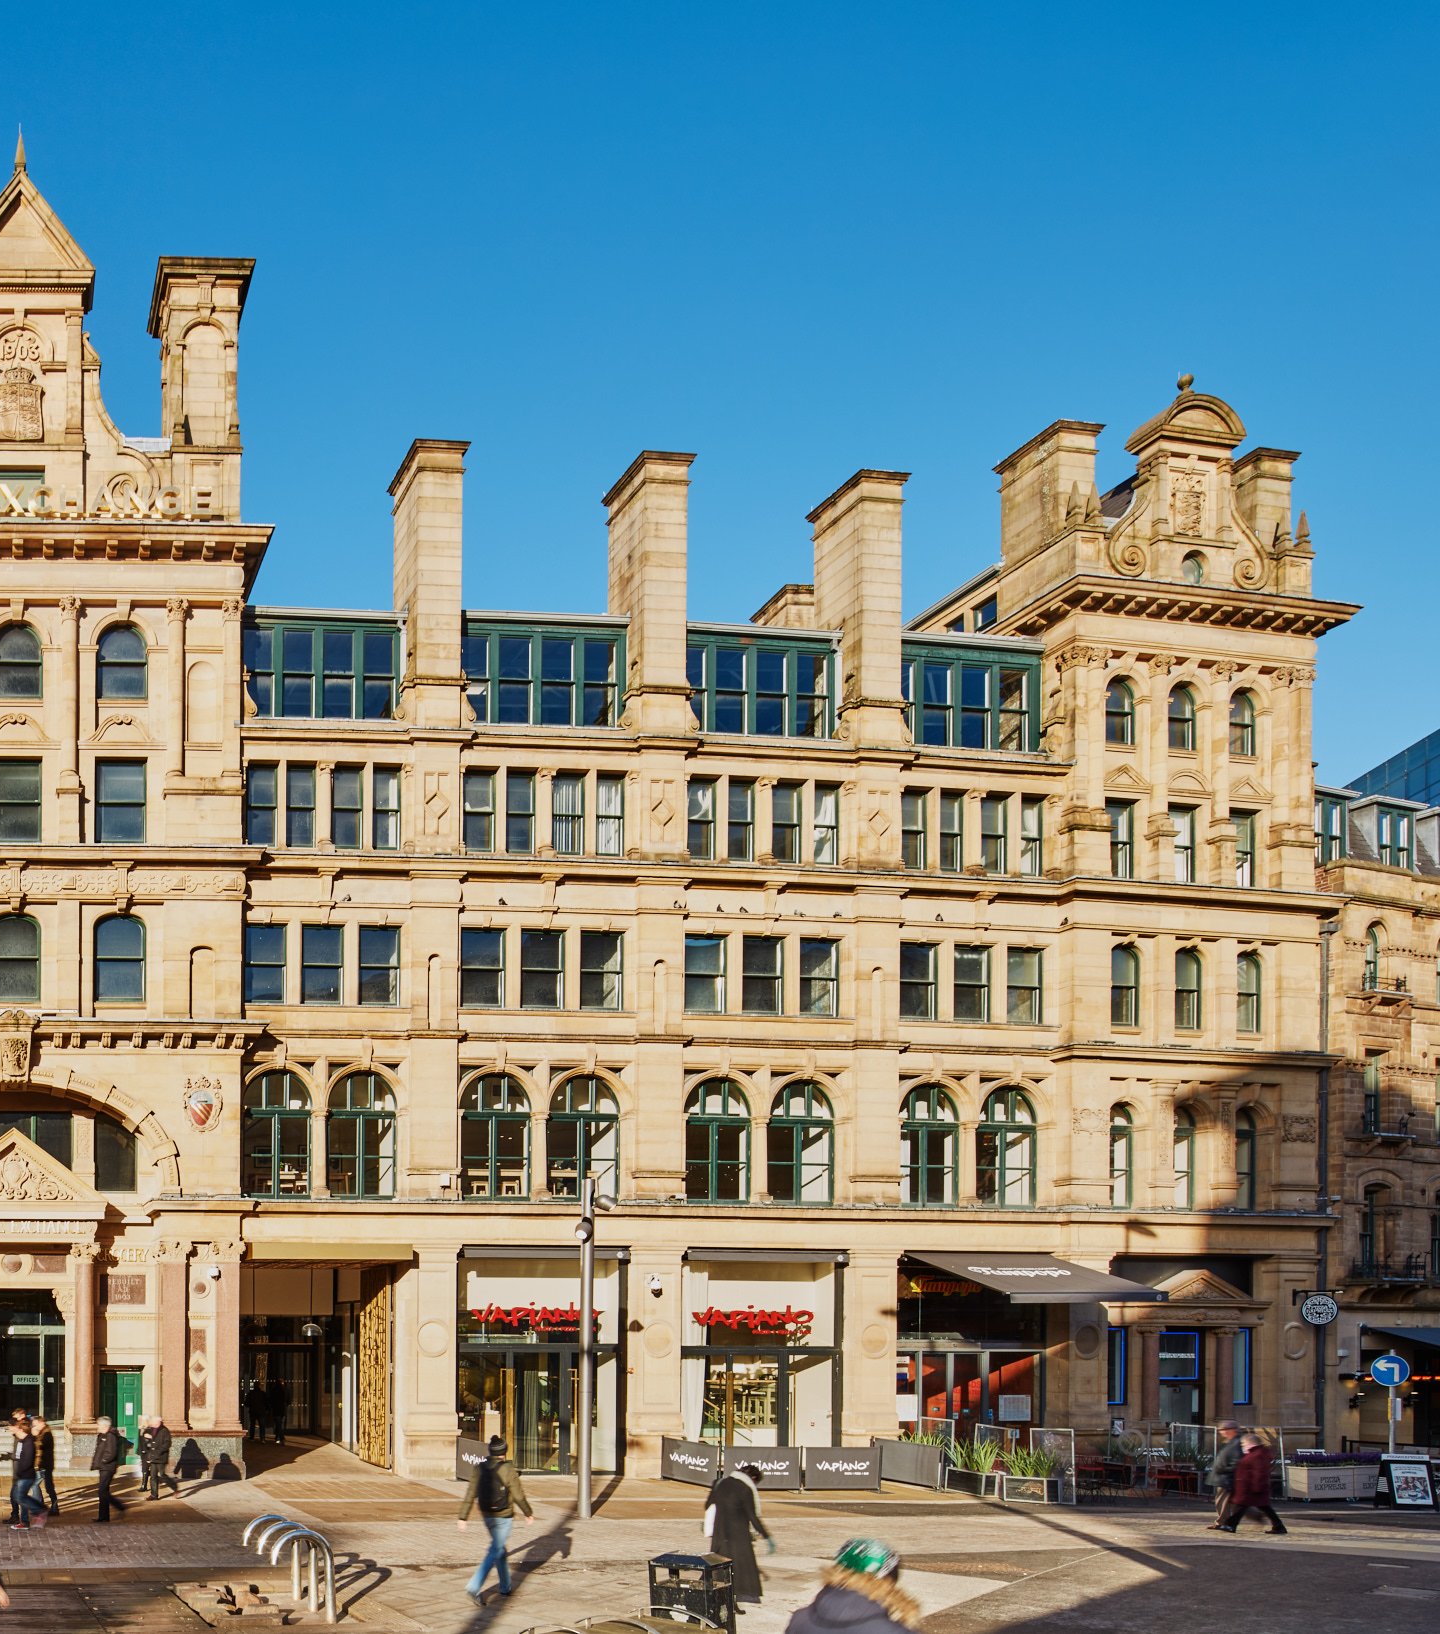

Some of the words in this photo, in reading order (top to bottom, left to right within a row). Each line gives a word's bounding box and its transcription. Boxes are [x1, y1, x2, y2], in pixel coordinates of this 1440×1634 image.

[691, 1304, 815, 1330] VAPIANO
[669, 1451, 707, 1466] VAPIANO
[816, 1460, 868, 1473] VAPIANO
